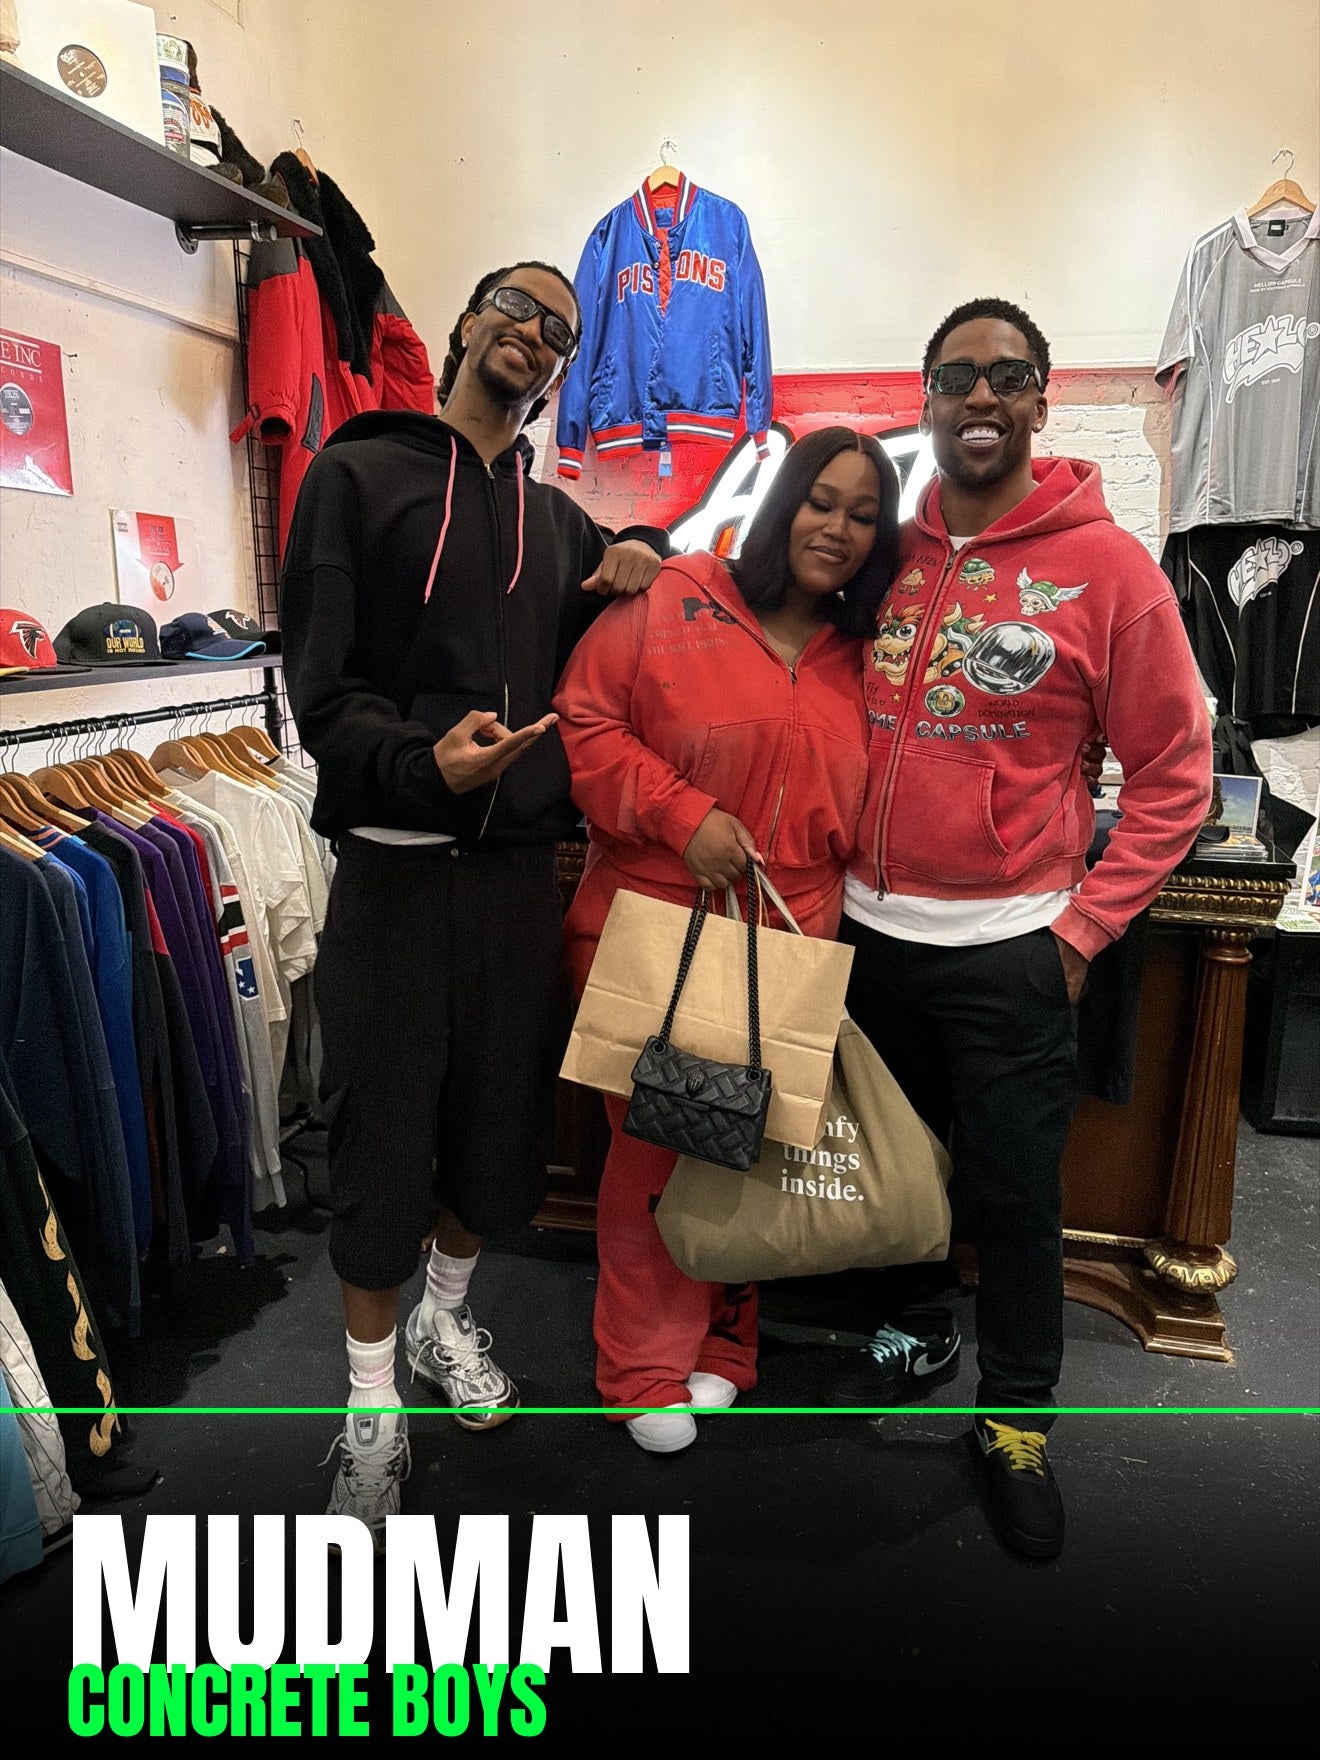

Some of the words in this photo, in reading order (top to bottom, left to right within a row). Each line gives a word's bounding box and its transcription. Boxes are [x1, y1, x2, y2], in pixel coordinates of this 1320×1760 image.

[617, 249, 727, 303] PISONS
[14, 343, 42, 368] INC
[106, 637, 122, 648] OUR
[122, 637, 144, 648] WORLD
[977, 698, 1035, 718] DOMINATION
[988, 699, 1019, 708] WORLD
[915, 720, 1030, 742] CAPSULE
[781, 1168, 864, 1202] inside.
